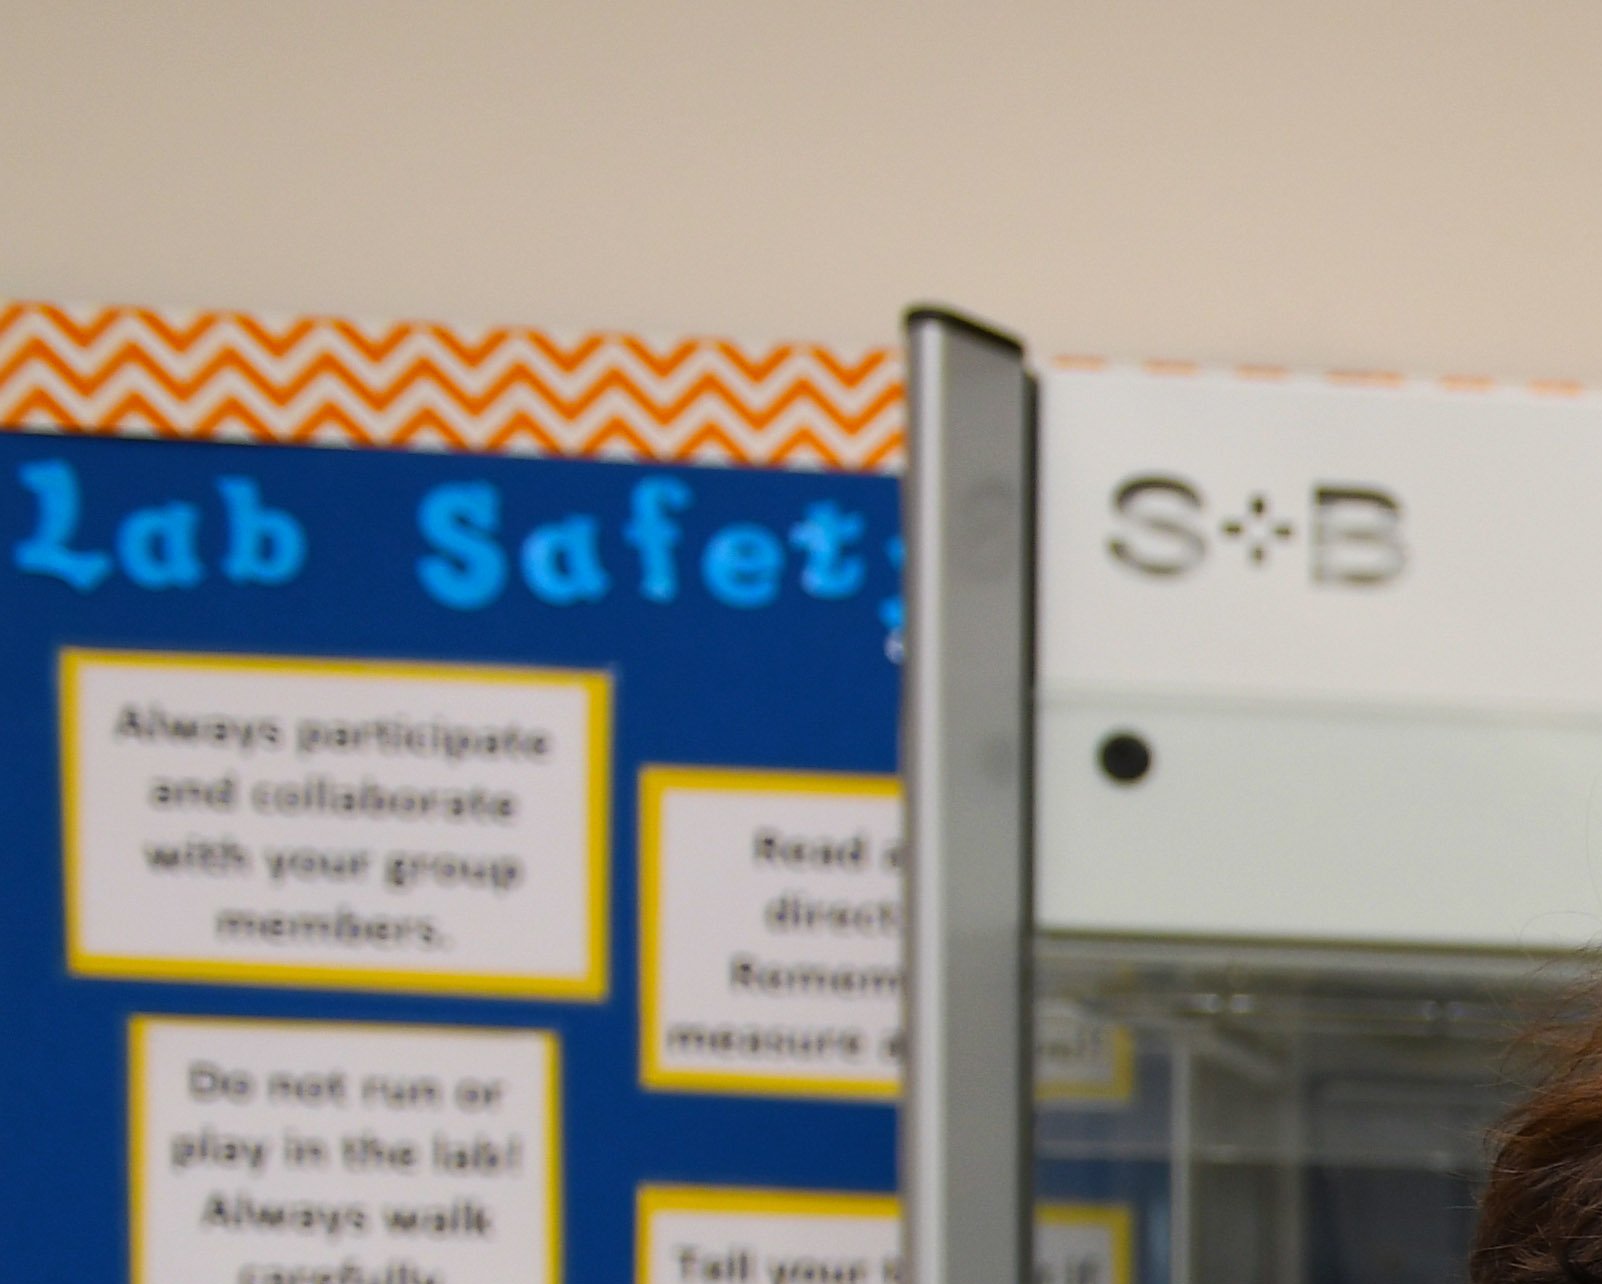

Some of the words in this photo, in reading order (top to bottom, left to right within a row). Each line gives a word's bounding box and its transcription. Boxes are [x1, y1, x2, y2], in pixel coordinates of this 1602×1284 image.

[14, 458, 308, 591] Lab
[414, 475, 905, 632] Safet
[114, 706, 282, 751] Always
[296, 716, 551, 765] participate
[149, 774, 239, 812] and
[250, 776, 518, 824] collaborate
[144, 838, 251, 875] with
[265, 847, 369, 885] your
[384, 852, 524, 895] group
[752, 830, 870, 870] Read
[215, 907, 452, 949] members.
[668, 1022, 864, 1062] measure
[187, 1061, 256, 1104] Do
[267, 1070, 348, 1106] not
[361, 1075, 443, 1111] run
[453, 1079, 503, 1112] or
[170, 1131, 269, 1172] play
[283, 1136, 328, 1167] in
[341, 1135, 418, 1172] the
[432, 1138, 522, 1176] lab!
[202, 1195, 368, 1236] Always
[384, 1199, 492, 1237] walk
